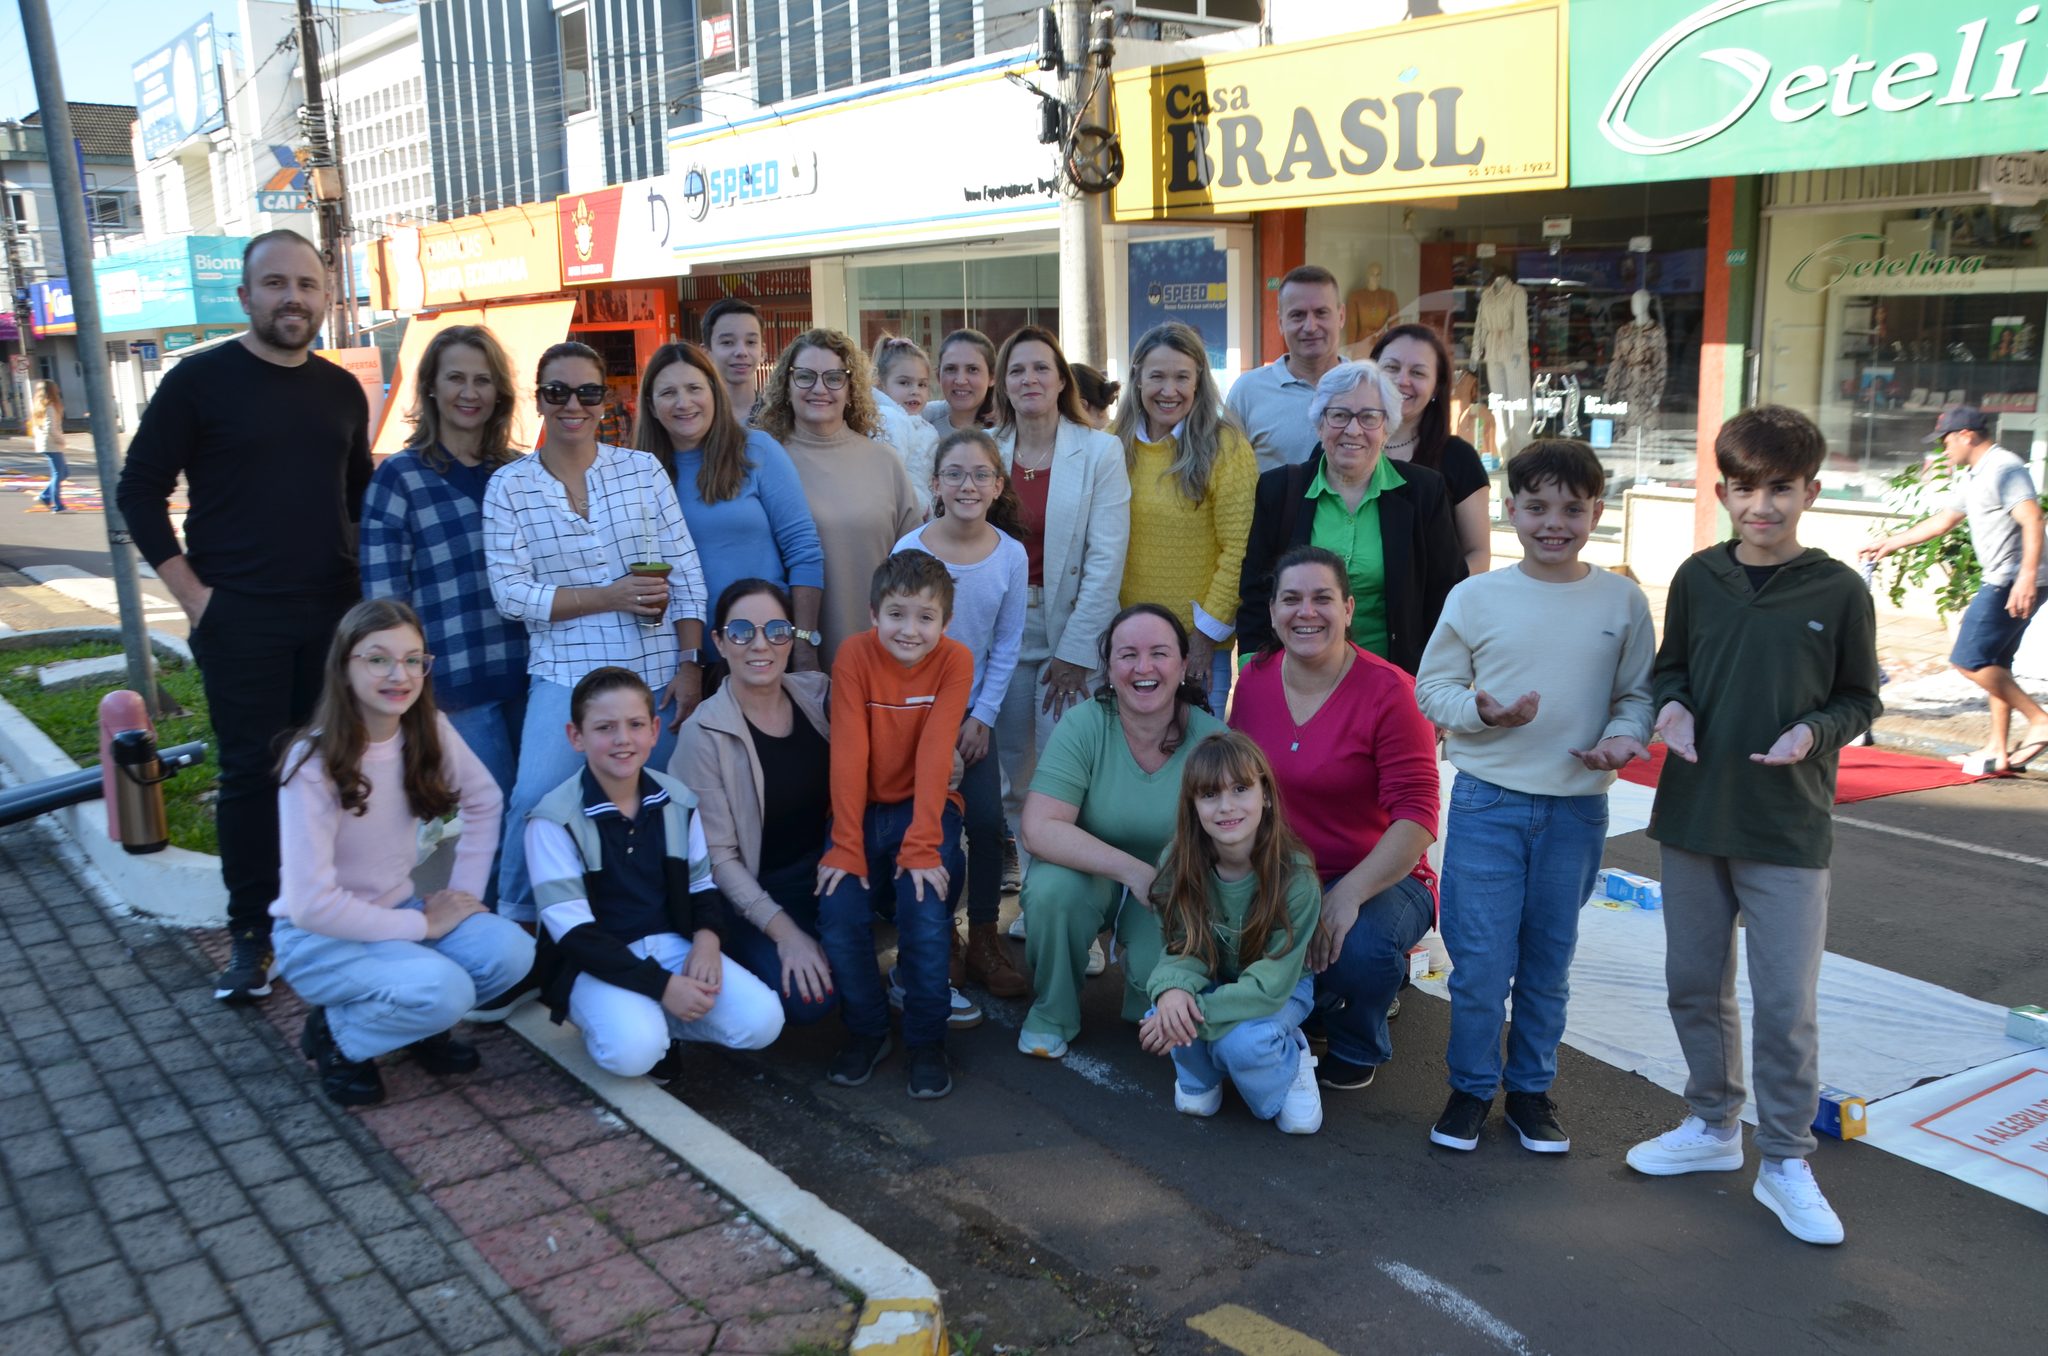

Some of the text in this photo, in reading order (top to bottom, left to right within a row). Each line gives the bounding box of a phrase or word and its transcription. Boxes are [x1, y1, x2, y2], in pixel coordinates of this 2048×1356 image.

[1166, 83, 1250, 120] Casa
[1599, 0, 2048, 155] Geteli
[1167, 86, 1486, 193] BRASIL
[195, 253, 244, 270] Biom
